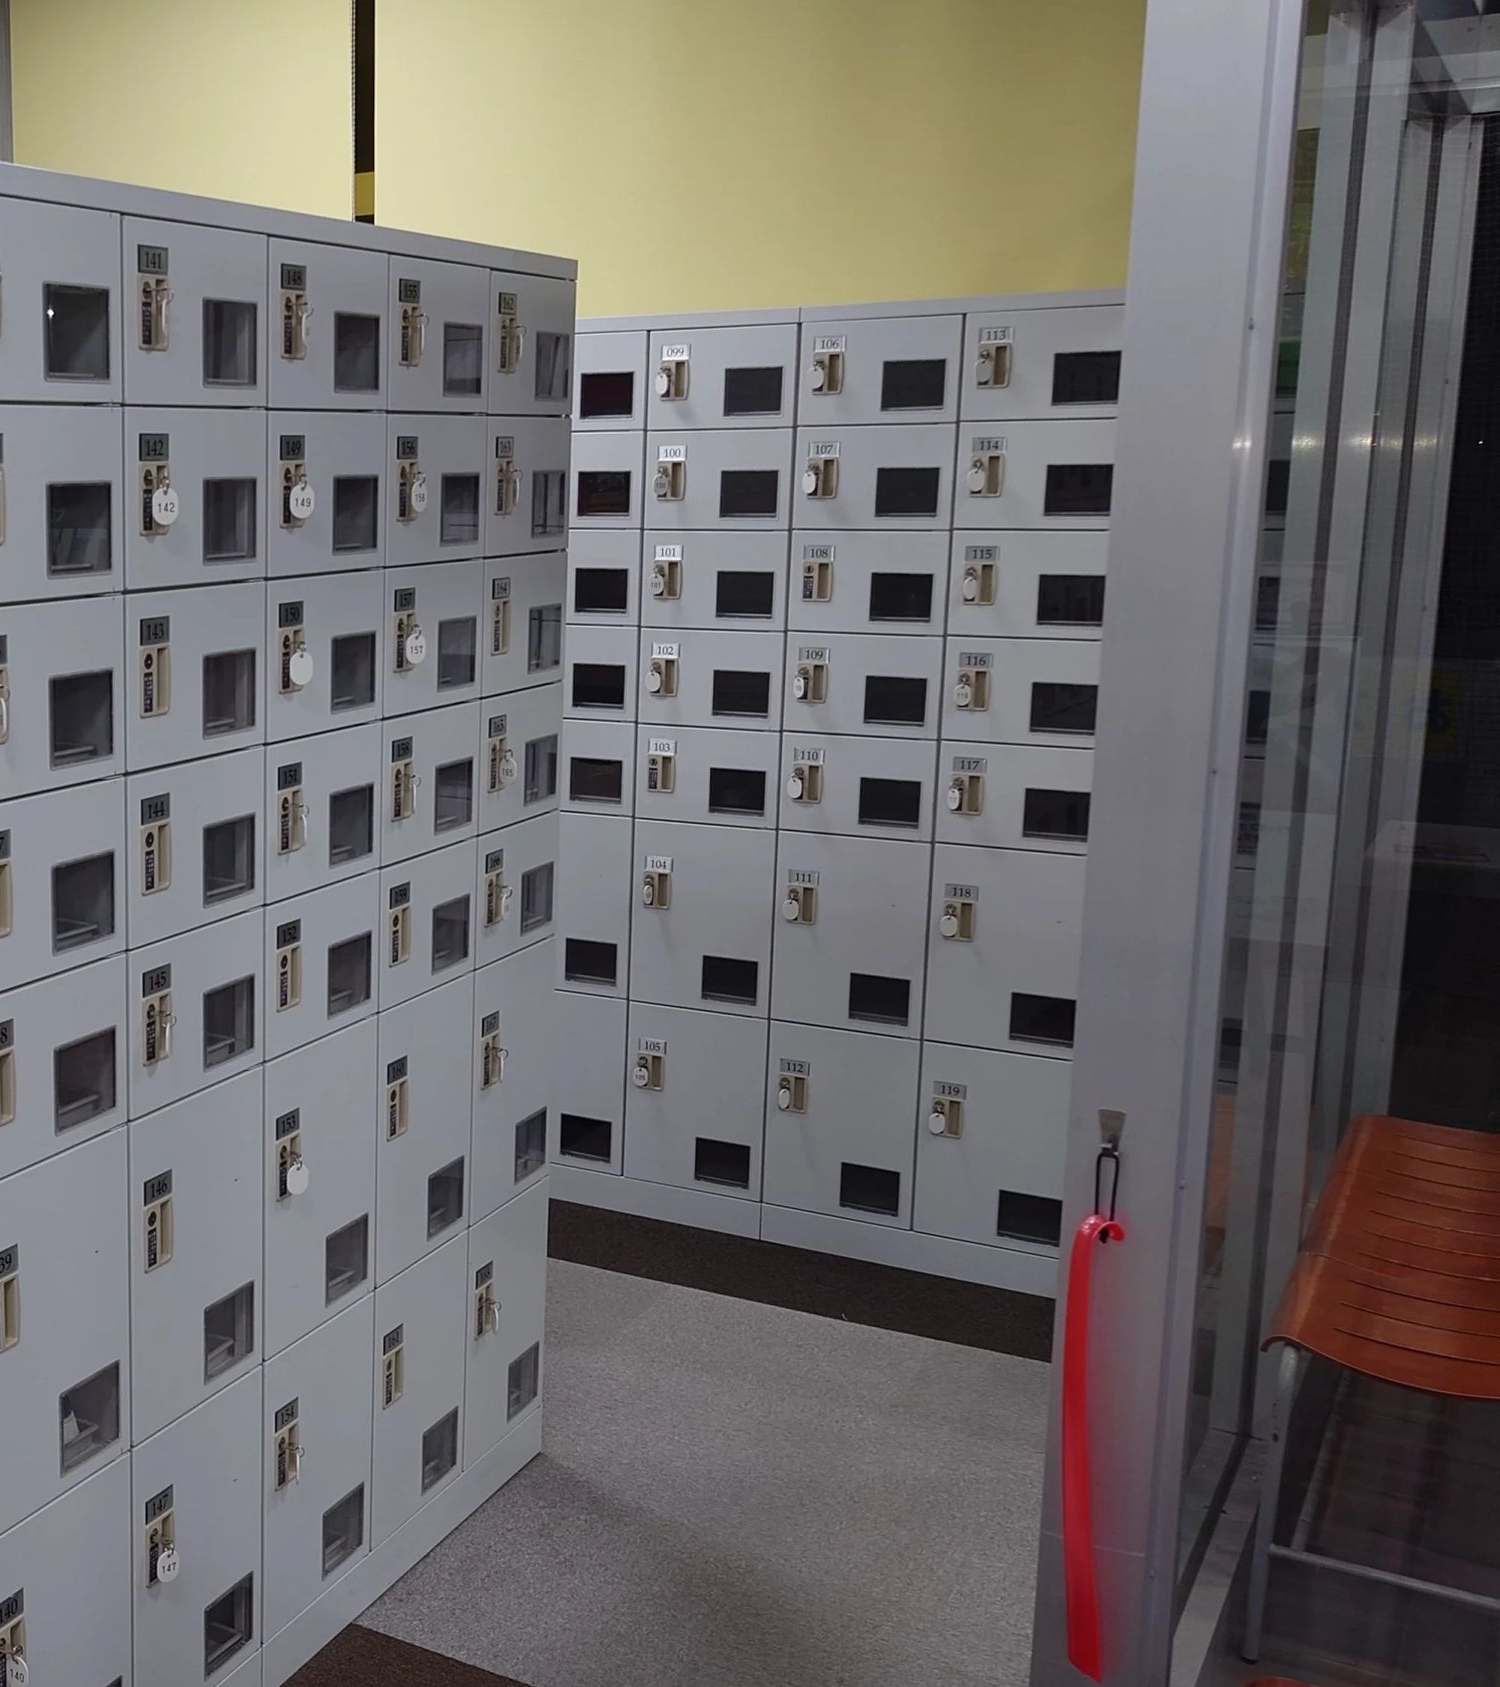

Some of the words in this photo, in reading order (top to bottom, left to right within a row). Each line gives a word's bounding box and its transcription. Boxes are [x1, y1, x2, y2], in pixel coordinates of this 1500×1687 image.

[144, 251, 163, 269] 141
[986, 329, 1005, 341] 113
[820, 338, 839, 350] 106
[666, 346, 685, 358] 099
[145, 440, 164, 456] 142
[286, 440, 301, 455] 149
[402, 441, 416, 456] 156
[814, 444, 833, 455] 107
[978, 440, 999, 451] 114
[664, 448, 681, 458] 100
[157, 501, 175, 513] 142
[294, 497, 311, 508] 149
[660, 547, 676, 557] 101
[809, 548, 828, 559] 108
[972, 548, 992, 560] 115
[400, 592, 412, 607] 157
[284, 607, 300, 623] 150
[145, 622, 164, 640] 143
[409, 645, 424, 655] 157
[656, 645, 674, 656] 102
[805, 650, 823, 660] 109
[966, 655, 986, 666] 116
[653, 742, 670, 752] 103
[799, 751, 818, 761] 110
[960, 759, 979, 770] 117
[283, 767, 298, 785] 151
[502, 767, 514, 777] 165
[146, 800, 165, 818] 144
[650, 859, 667, 869] 104
[795, 873, 813, 883] 111
[952, 887, 972, 898] 118
[282, 926, 297, 942] 152
[148, 970, 167, 988] 145
[645, 1041, 661, 1051] 105
[786, 1062, 804, 1073] 112
[940, 1085, 960, 1097] 119
[281, 1115, 297, 1133] 153
[150, 1178, 168, 1198] 146
[280, 1405, 295, 1425] 154
[151, 1491, 169, 1514] 147
[161, 1561, 177, 1573] 147
[0, 1597, 18, 1619] 140
[10, 1668, 25, 1682] 140
